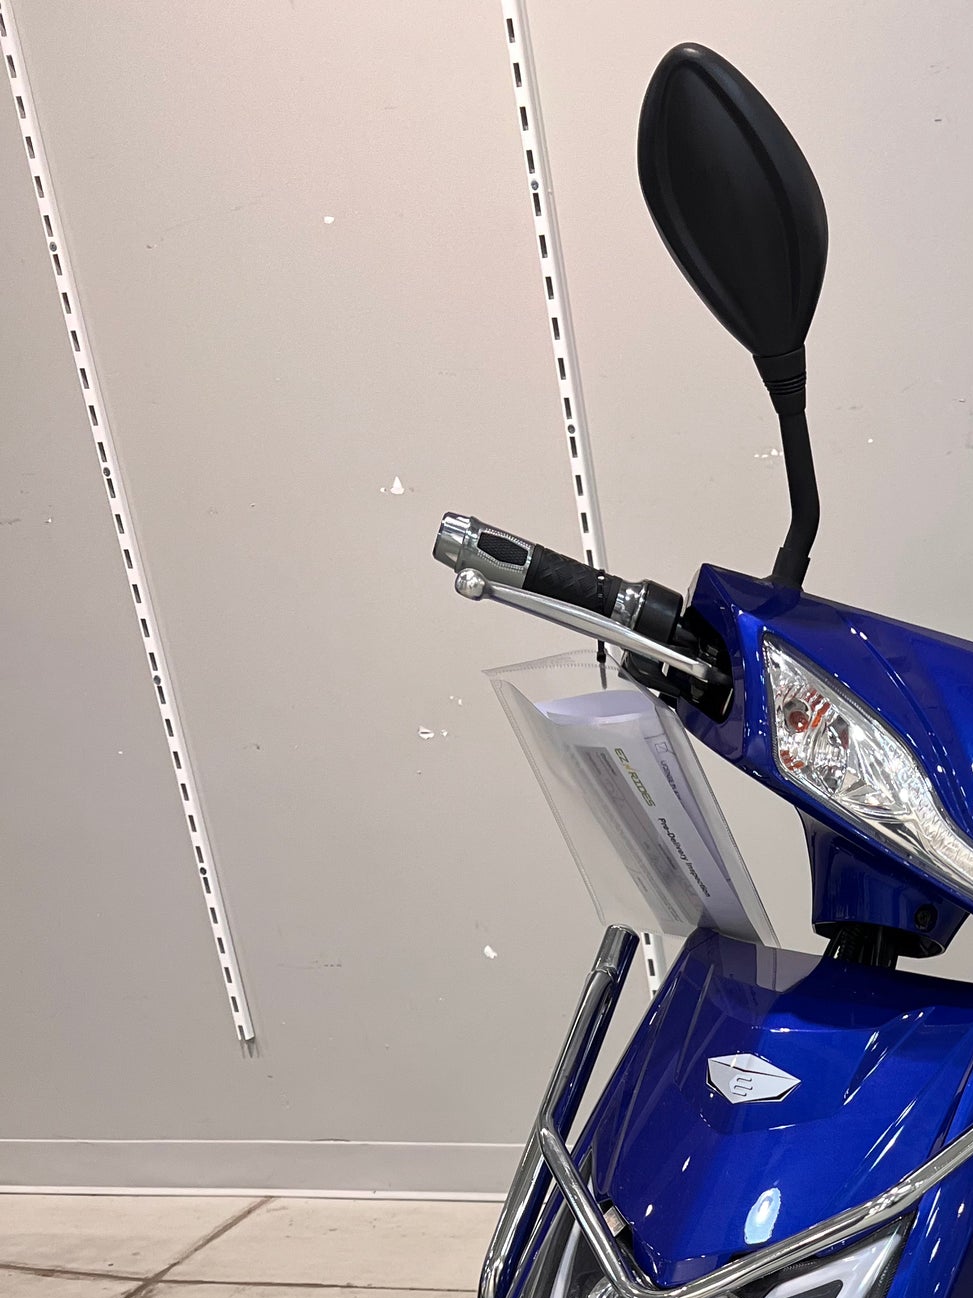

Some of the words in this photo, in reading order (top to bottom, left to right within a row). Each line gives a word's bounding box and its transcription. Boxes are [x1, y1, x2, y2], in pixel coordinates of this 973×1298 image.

[628, 770, 656, 807] RIDES
[658, 817, 688, 861] Pre-Delivery
[685, 862, 711, 898] Inspection
